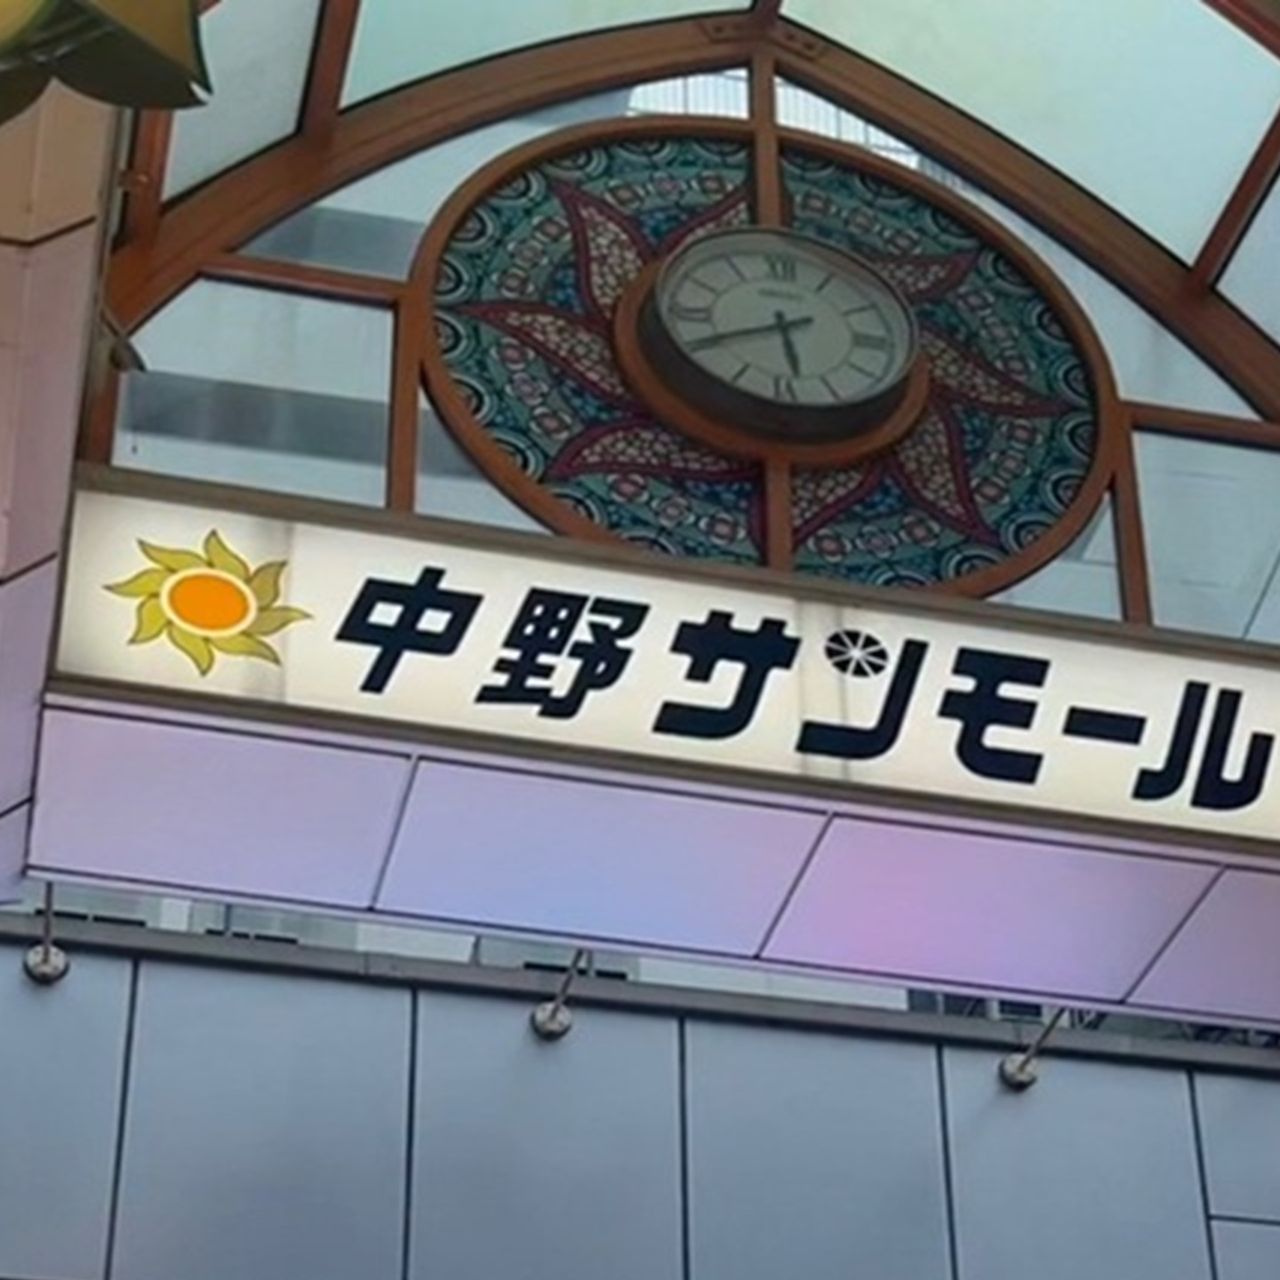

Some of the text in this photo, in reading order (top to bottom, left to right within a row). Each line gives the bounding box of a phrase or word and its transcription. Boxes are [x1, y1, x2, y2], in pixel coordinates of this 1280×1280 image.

[334, 566, 1274, 809] 中野サンモール
